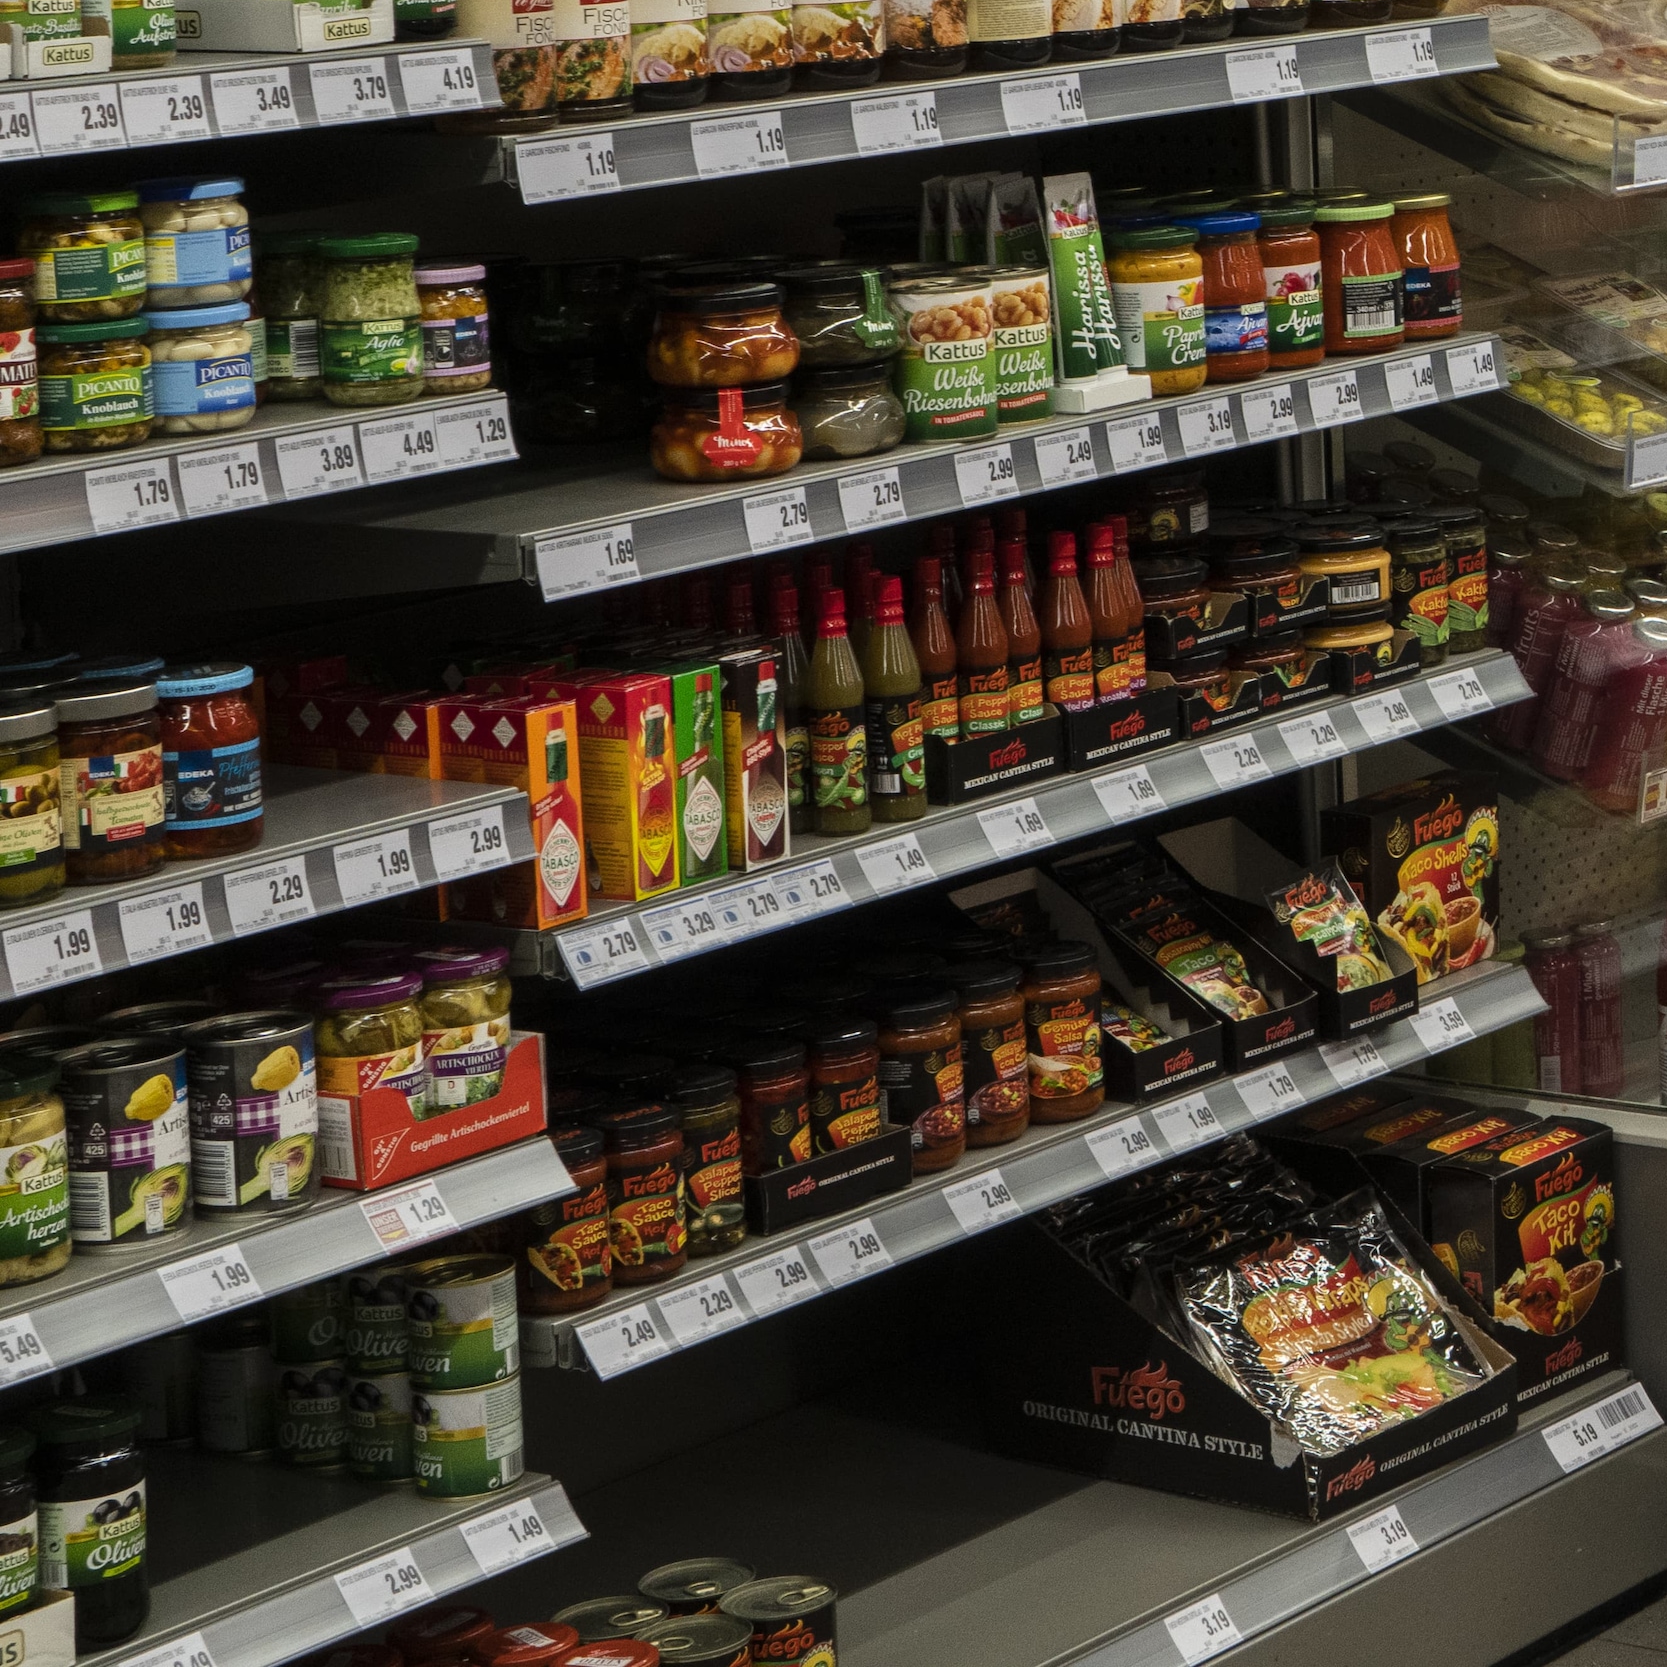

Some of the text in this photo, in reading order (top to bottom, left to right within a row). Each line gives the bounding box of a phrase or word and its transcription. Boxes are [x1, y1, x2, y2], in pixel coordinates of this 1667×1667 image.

[443, 66, 475, 92] 4.19
[586, 151, 616, 177] 1.19
[1072, 249, 1099, 360] Harissa
[1291, 291, 1321, 305] Kattus
[364, 335, 404, 353] Aglio
[928, 341, 985, 362] Kattus
[201, 359, 252, 382] PICANTO
[1473, 352, 1493, 374] 1.49
[78, 375, 139, 400] PICANTO
[934, 366, 985, 392] Weiße
[81, 397, 138, 415] Knoblauch
[475, 417, 507, 444] 1.29
[321, 444, 354, 473] 3.89
[605, 538, 634, 568] 1.69
[1458, 679, 1483, 702] 2.79
[1646, 675, 1665, 717] Flasche
[178, 768, 214, 780] EDEKA
[963, 756, 1055, 790] MEXICAN CANTINA STYLE
[1414, 793, 1464, 846] Fuego
[541, 854, 581, 870] TABASCO
[1400, 841, 1469, 881] Taco Shells
[683, 910, 716, 937] 3.29
[1439, 1009, 1465, 1033] 3.59
[410, 1100, 531, 1155] Gegrillte Artischockenviertel
[84, 1143, 107, 1158] 425
[24, 1169, 65, 1194] Kattus
[624, 1162, 676, 1196] Fuego
[1535, 1152, 1584, 1203] Fuego
[409, 1195, 446, 1226] 1.29
[632, 1205, 677, 1227] Sauce
[637, 1197, 673, 1216] Taco
[1532, 1200, 1582, 1238] Taco
[1547, 1224, 1577, 1257] Kit
[1091, 1360, 1186, 1421] Fuego
[1023, 1399, 1263, 1461] ORIGINAL CANTINA STYLE
[1380, 1402, 1510, 1474] ORIGINAL CANTINA STYLE
[1573, 1422, 1598, 1448] 5.19
[1381, 1518, 1408, 1548] 3.19
